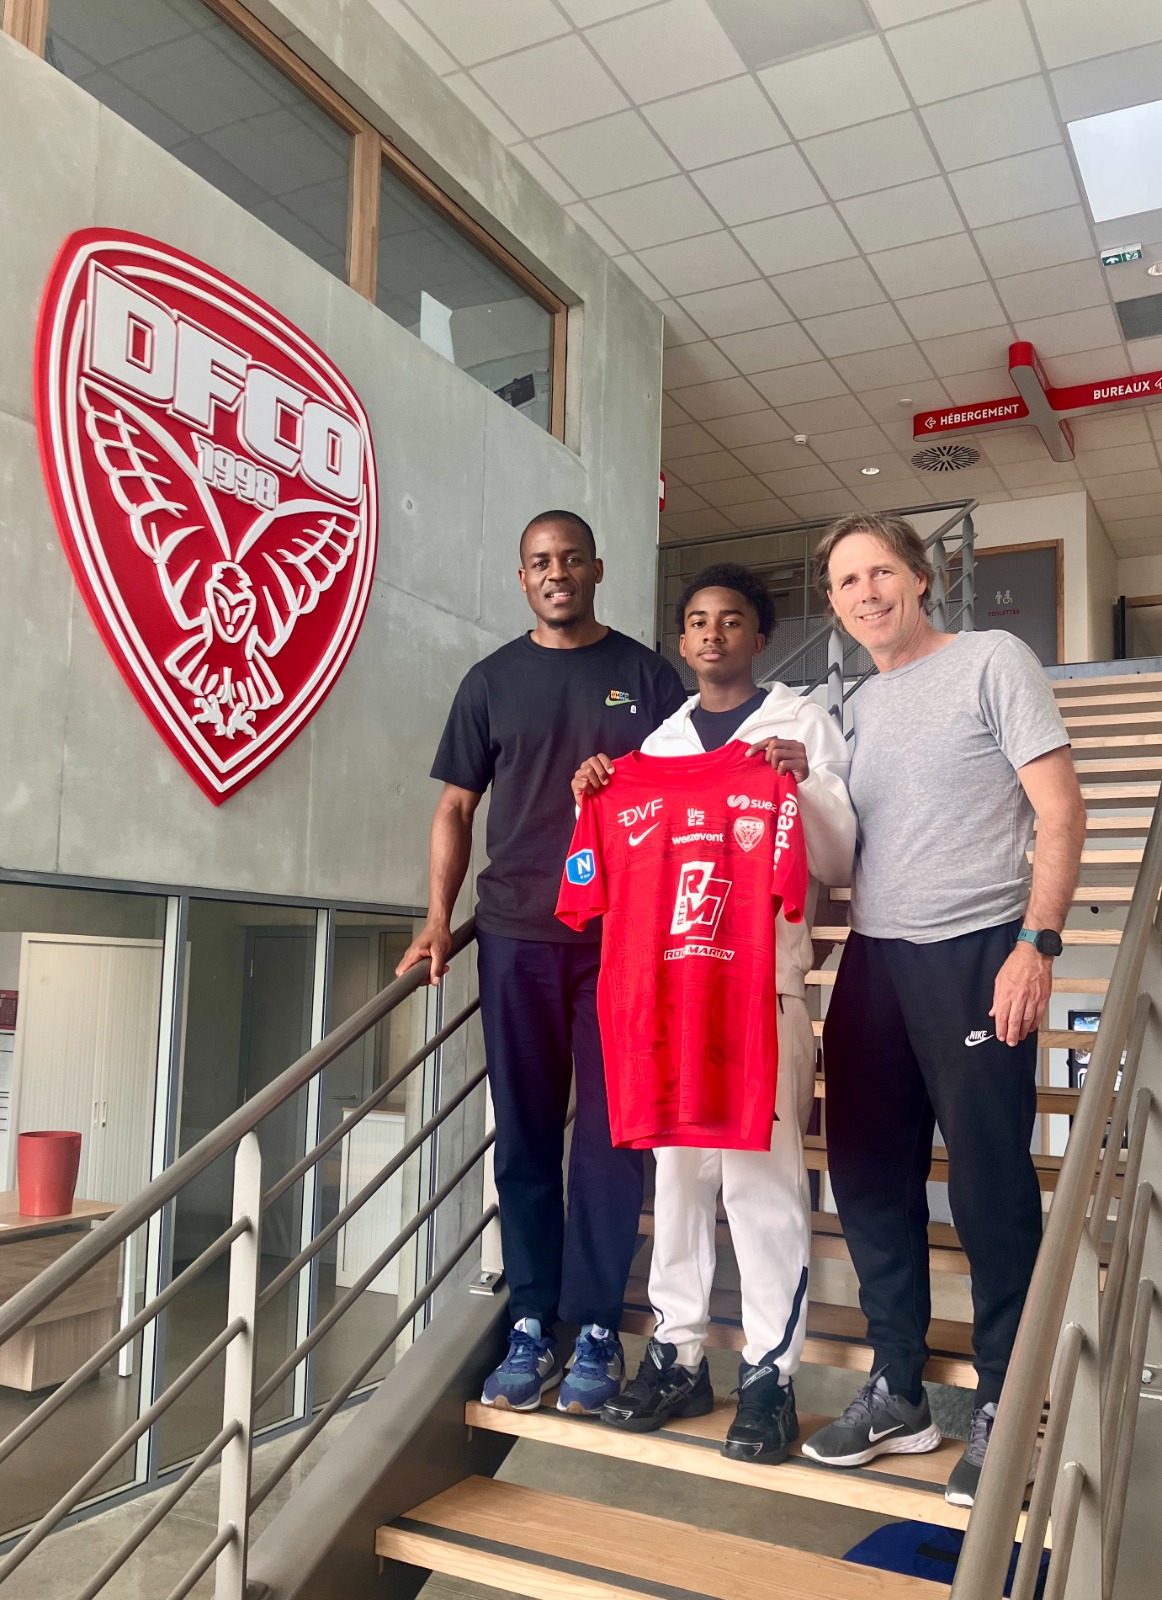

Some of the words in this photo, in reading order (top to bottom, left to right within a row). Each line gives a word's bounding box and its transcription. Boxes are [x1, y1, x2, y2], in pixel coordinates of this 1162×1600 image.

[84, 260, 363, 506] DFCO
[1093, 381, 1151, 400] BUREAUX
[940, 403, 1020, 426] HÉBERGEMENT
[192, 432, 279, 511] 1998
[987, 608, 1021, 618] TOILETTES
[969, 1030, 988, 1041] NIKE
